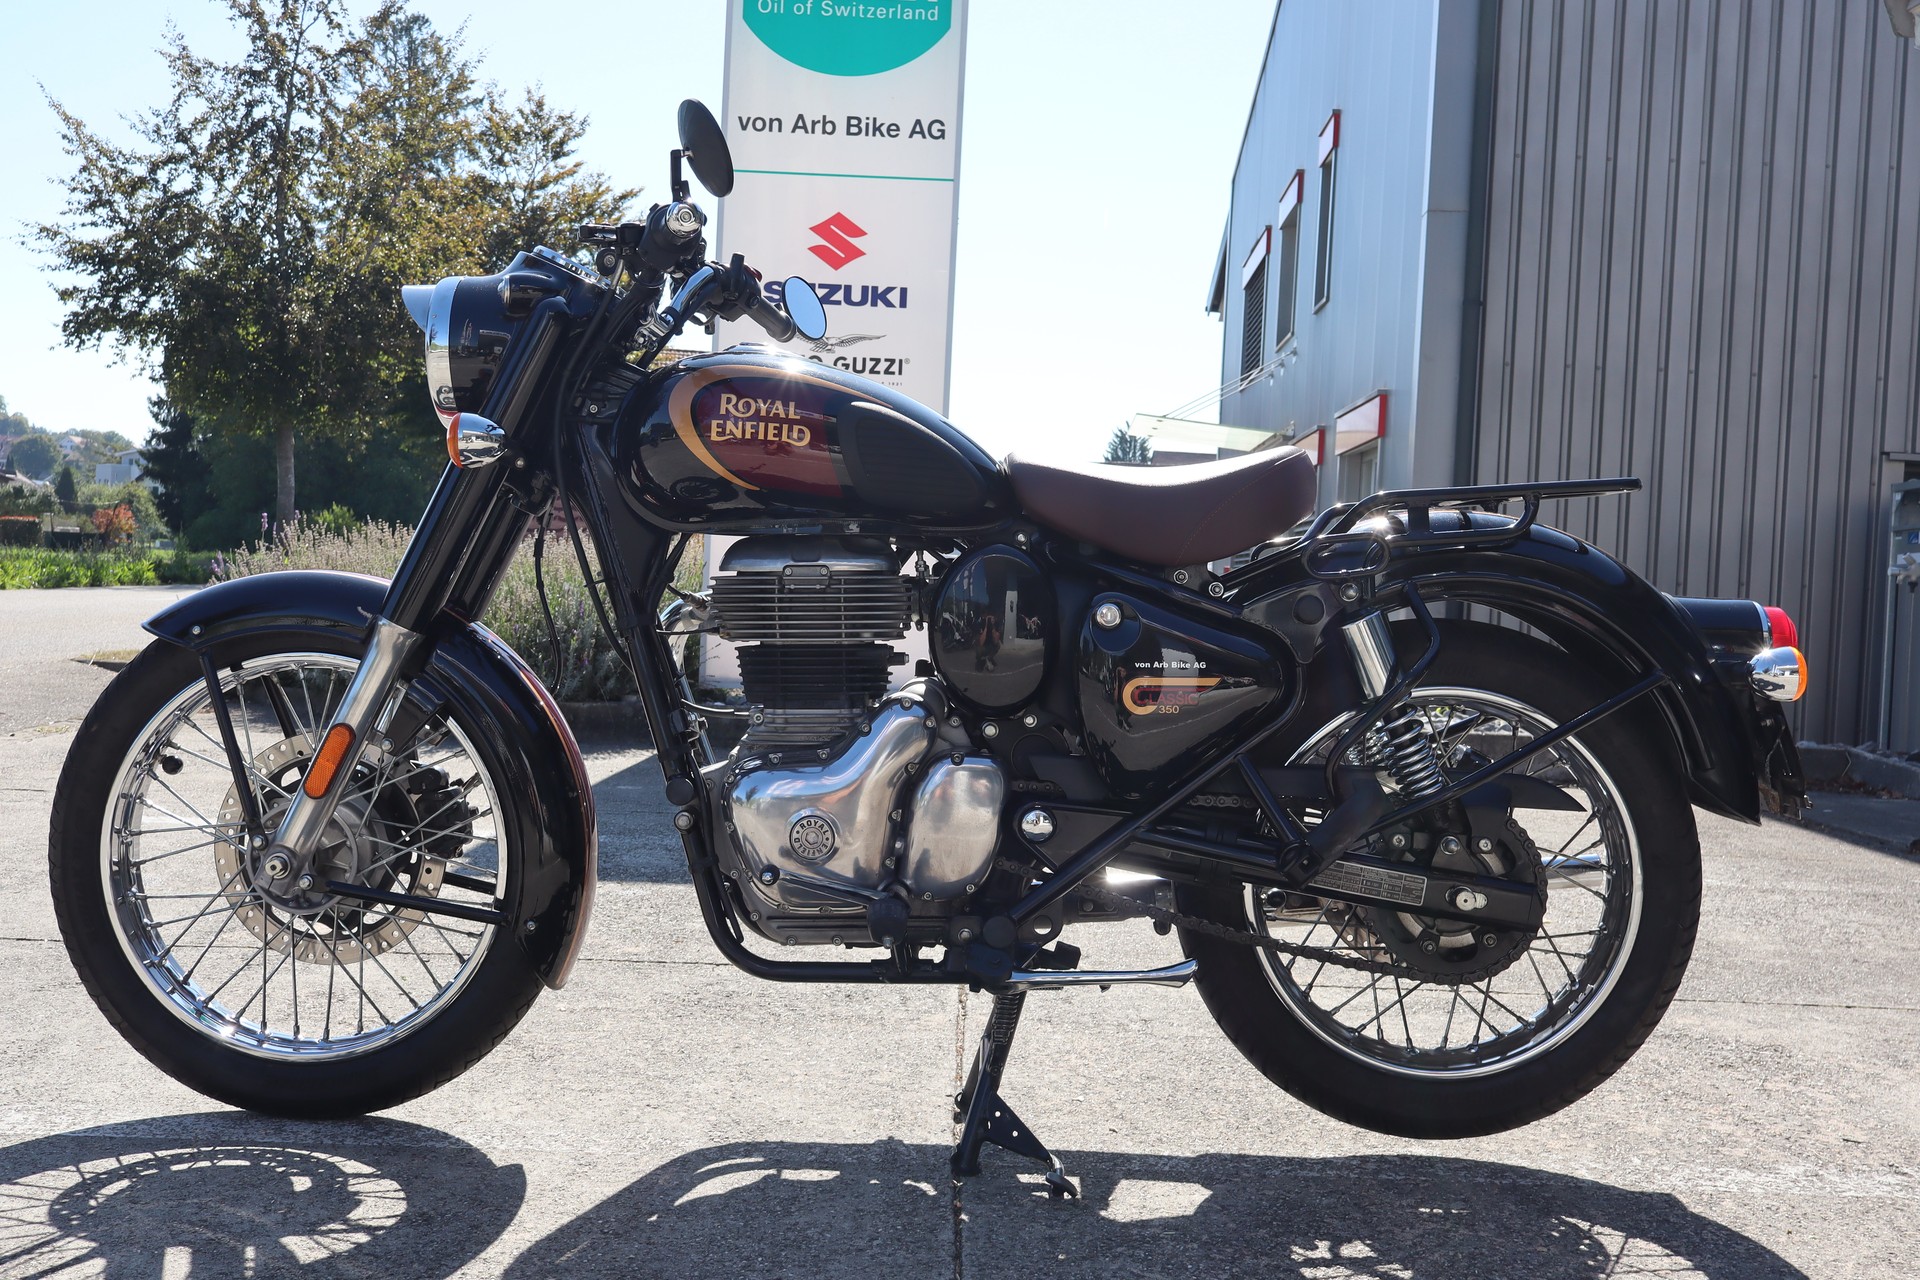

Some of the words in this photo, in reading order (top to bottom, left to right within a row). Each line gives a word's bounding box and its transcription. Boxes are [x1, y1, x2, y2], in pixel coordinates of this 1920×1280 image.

[757, 0, 784, 14] Oil
[793, 0, 813, 16] of
[821, 0, 939, 21] Switzerland
[737, 115, 783, 133] von
[790, 113, 836, 136] Arb
[846, 115, 901, 138] Bike
[908, 118, 946, 140] AG
[763, 281, 908, 309] SZUKI
[720, 393, 801, 420] ROYAL
[710, 419, 811, 447] ENFIELD
[1153, 661, 1169, 669] Arb
[1171, 661, 1191, 669] Bike
[1193, 661, 1207, 669] AG
[1130, 687, 1199, 706] CLASSIC
[1158, 705, 1180, 714] 350
[799, 819, 830, 836] ROYAL
[793, 838, 829, 857] ENFIELD
